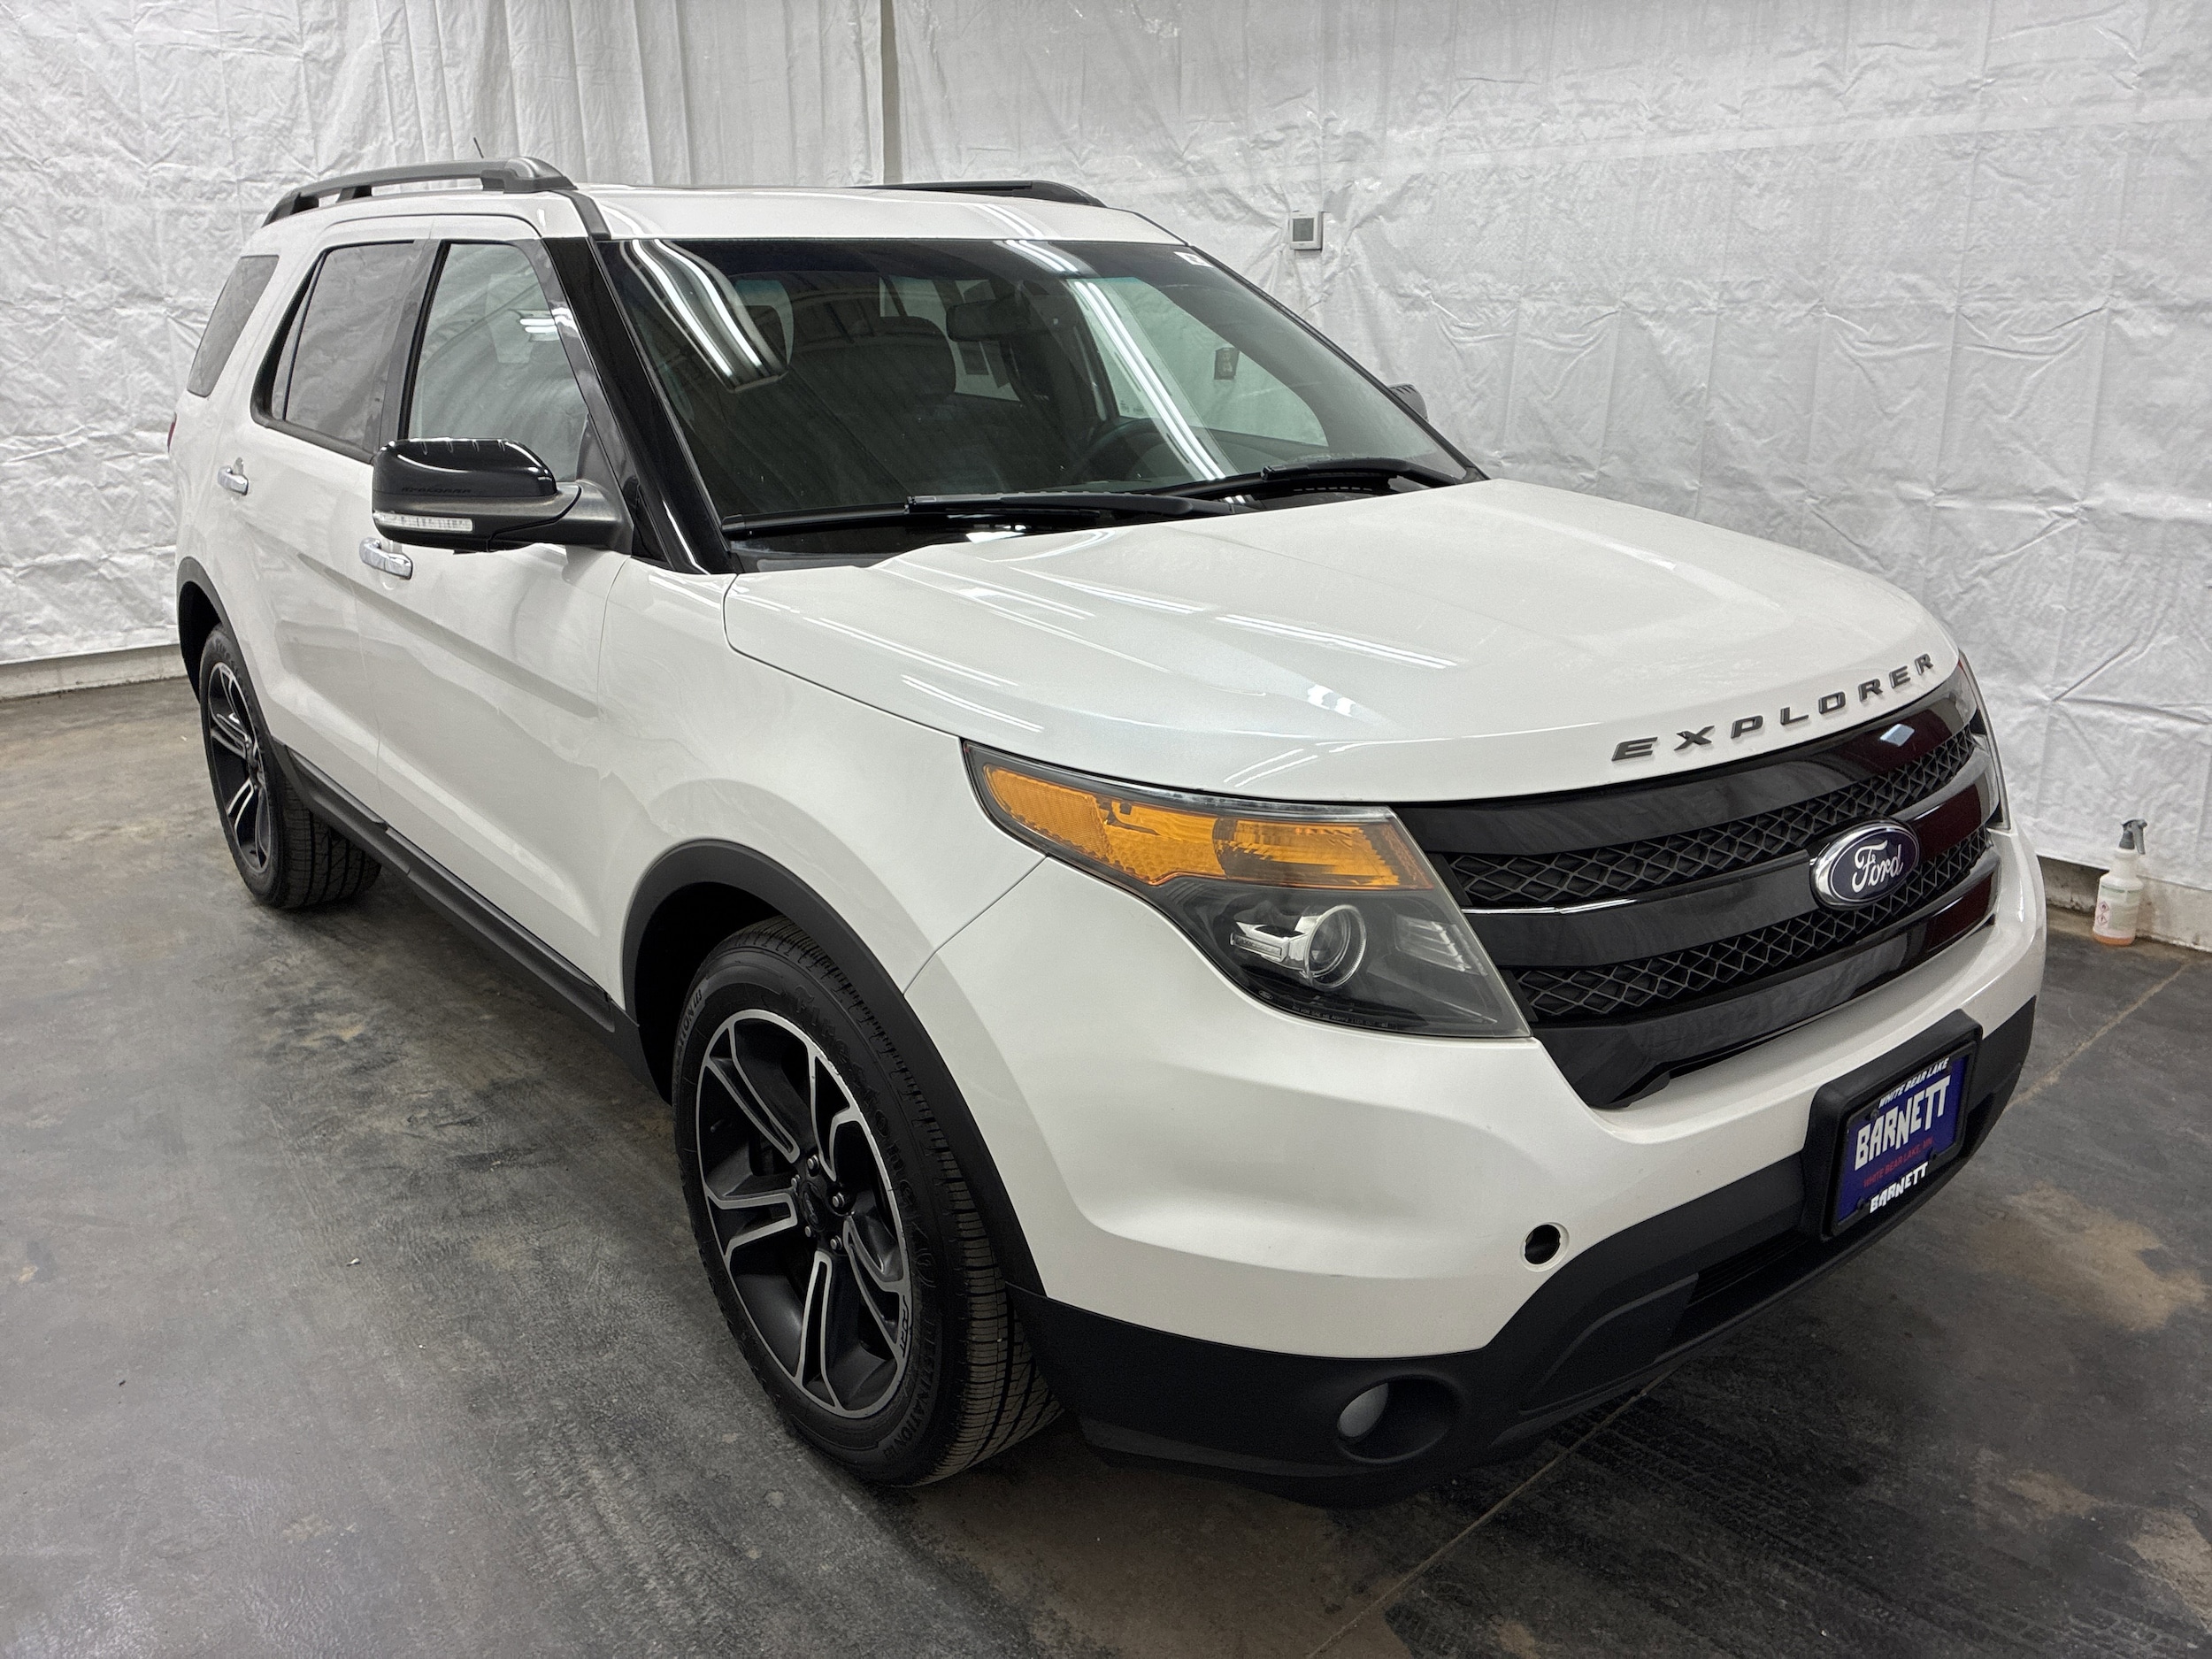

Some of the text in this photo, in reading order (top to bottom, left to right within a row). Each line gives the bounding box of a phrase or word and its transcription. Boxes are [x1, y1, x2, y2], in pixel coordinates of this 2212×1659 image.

[1611, 653, 1934, 762] EXPLORER
[1851, 840, 1904, 894] Ford
[1878, 1056, 1950, 1109] WHITE BEAR LAKE
[1855, 1075, 1951, 1171] BARNETT
[1863, 1167, 1885, 1188] WHITE
[1885, 1155, 1903, 1175] BEAR
[1869, 1162, 1929, 1214] BARNETT
